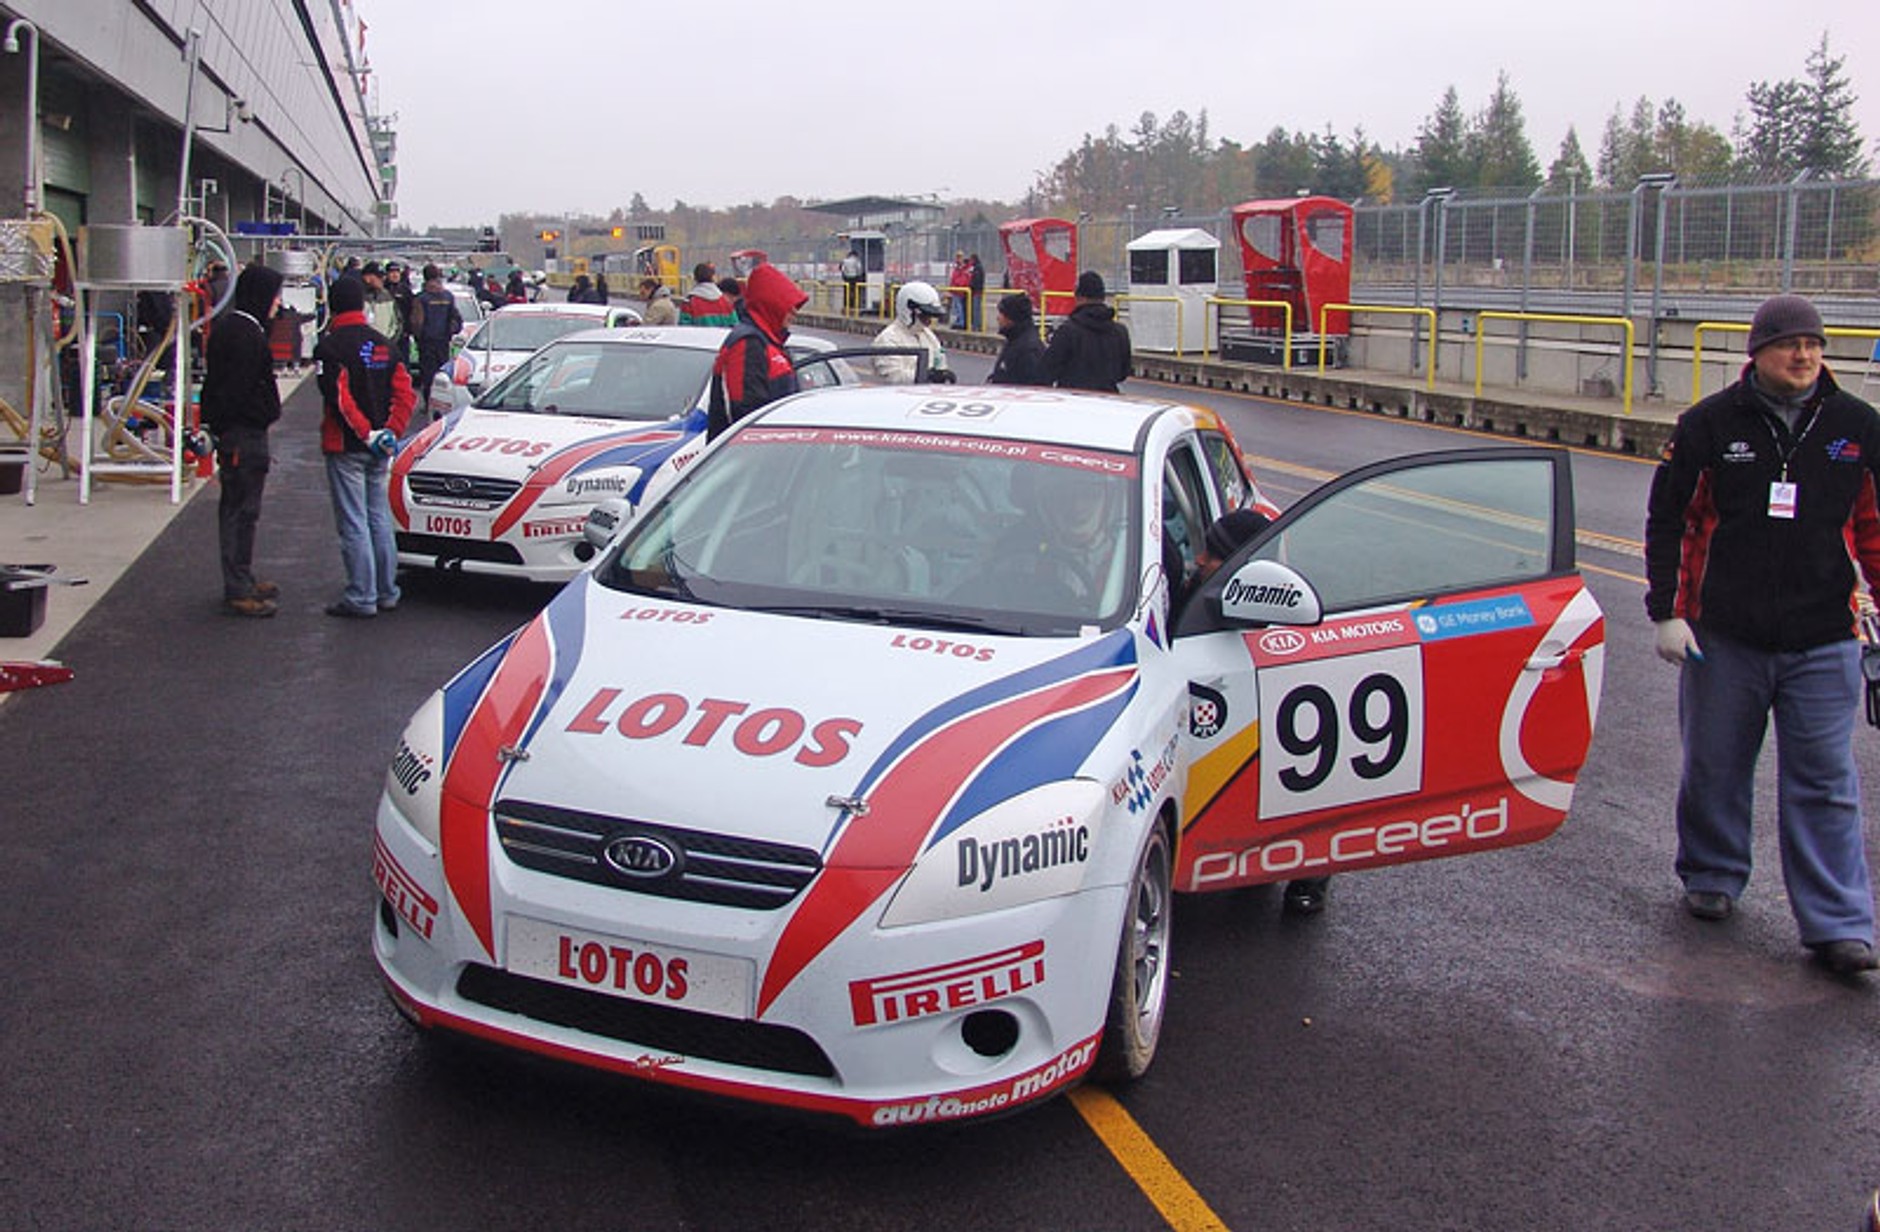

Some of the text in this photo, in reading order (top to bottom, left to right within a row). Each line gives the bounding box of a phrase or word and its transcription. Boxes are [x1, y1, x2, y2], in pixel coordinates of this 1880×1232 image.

[919, 400, 996, 418] 99
[439, 436, 552, 457] LOTOS
[833, 434, 1028, 455] www.kia-lotos-cup.pl
[566, 474, 627, 496] Dynamic
[427, 515, 471, 536] LOTOS
[1224, 577, 1302, 608] Dynamic
[619, 606, 714, 626] LOTOS
[1458, 608, 1496, 625] Money
[1268, 636, 1301, 651] KIA
[1310, 629, 1339, 644] KIA
[1341, 618, 1404, 639] MOTORS
[891, 634, 996, 663] LOTOS
[565, 687, 864, 768] LOTOS
[1276, 673, 1409, 793] 99
[1111, 777, 1131, 806] KIA
[615, 843, 661, 869] KIA
[957, 816, 1090, 893] Dynamic
[1189, 797, 1509, 892] pro_cee'd
[558, 936, 689, 1000] LOTOS
[848, 939, 1046, 1027] PIRELLI
